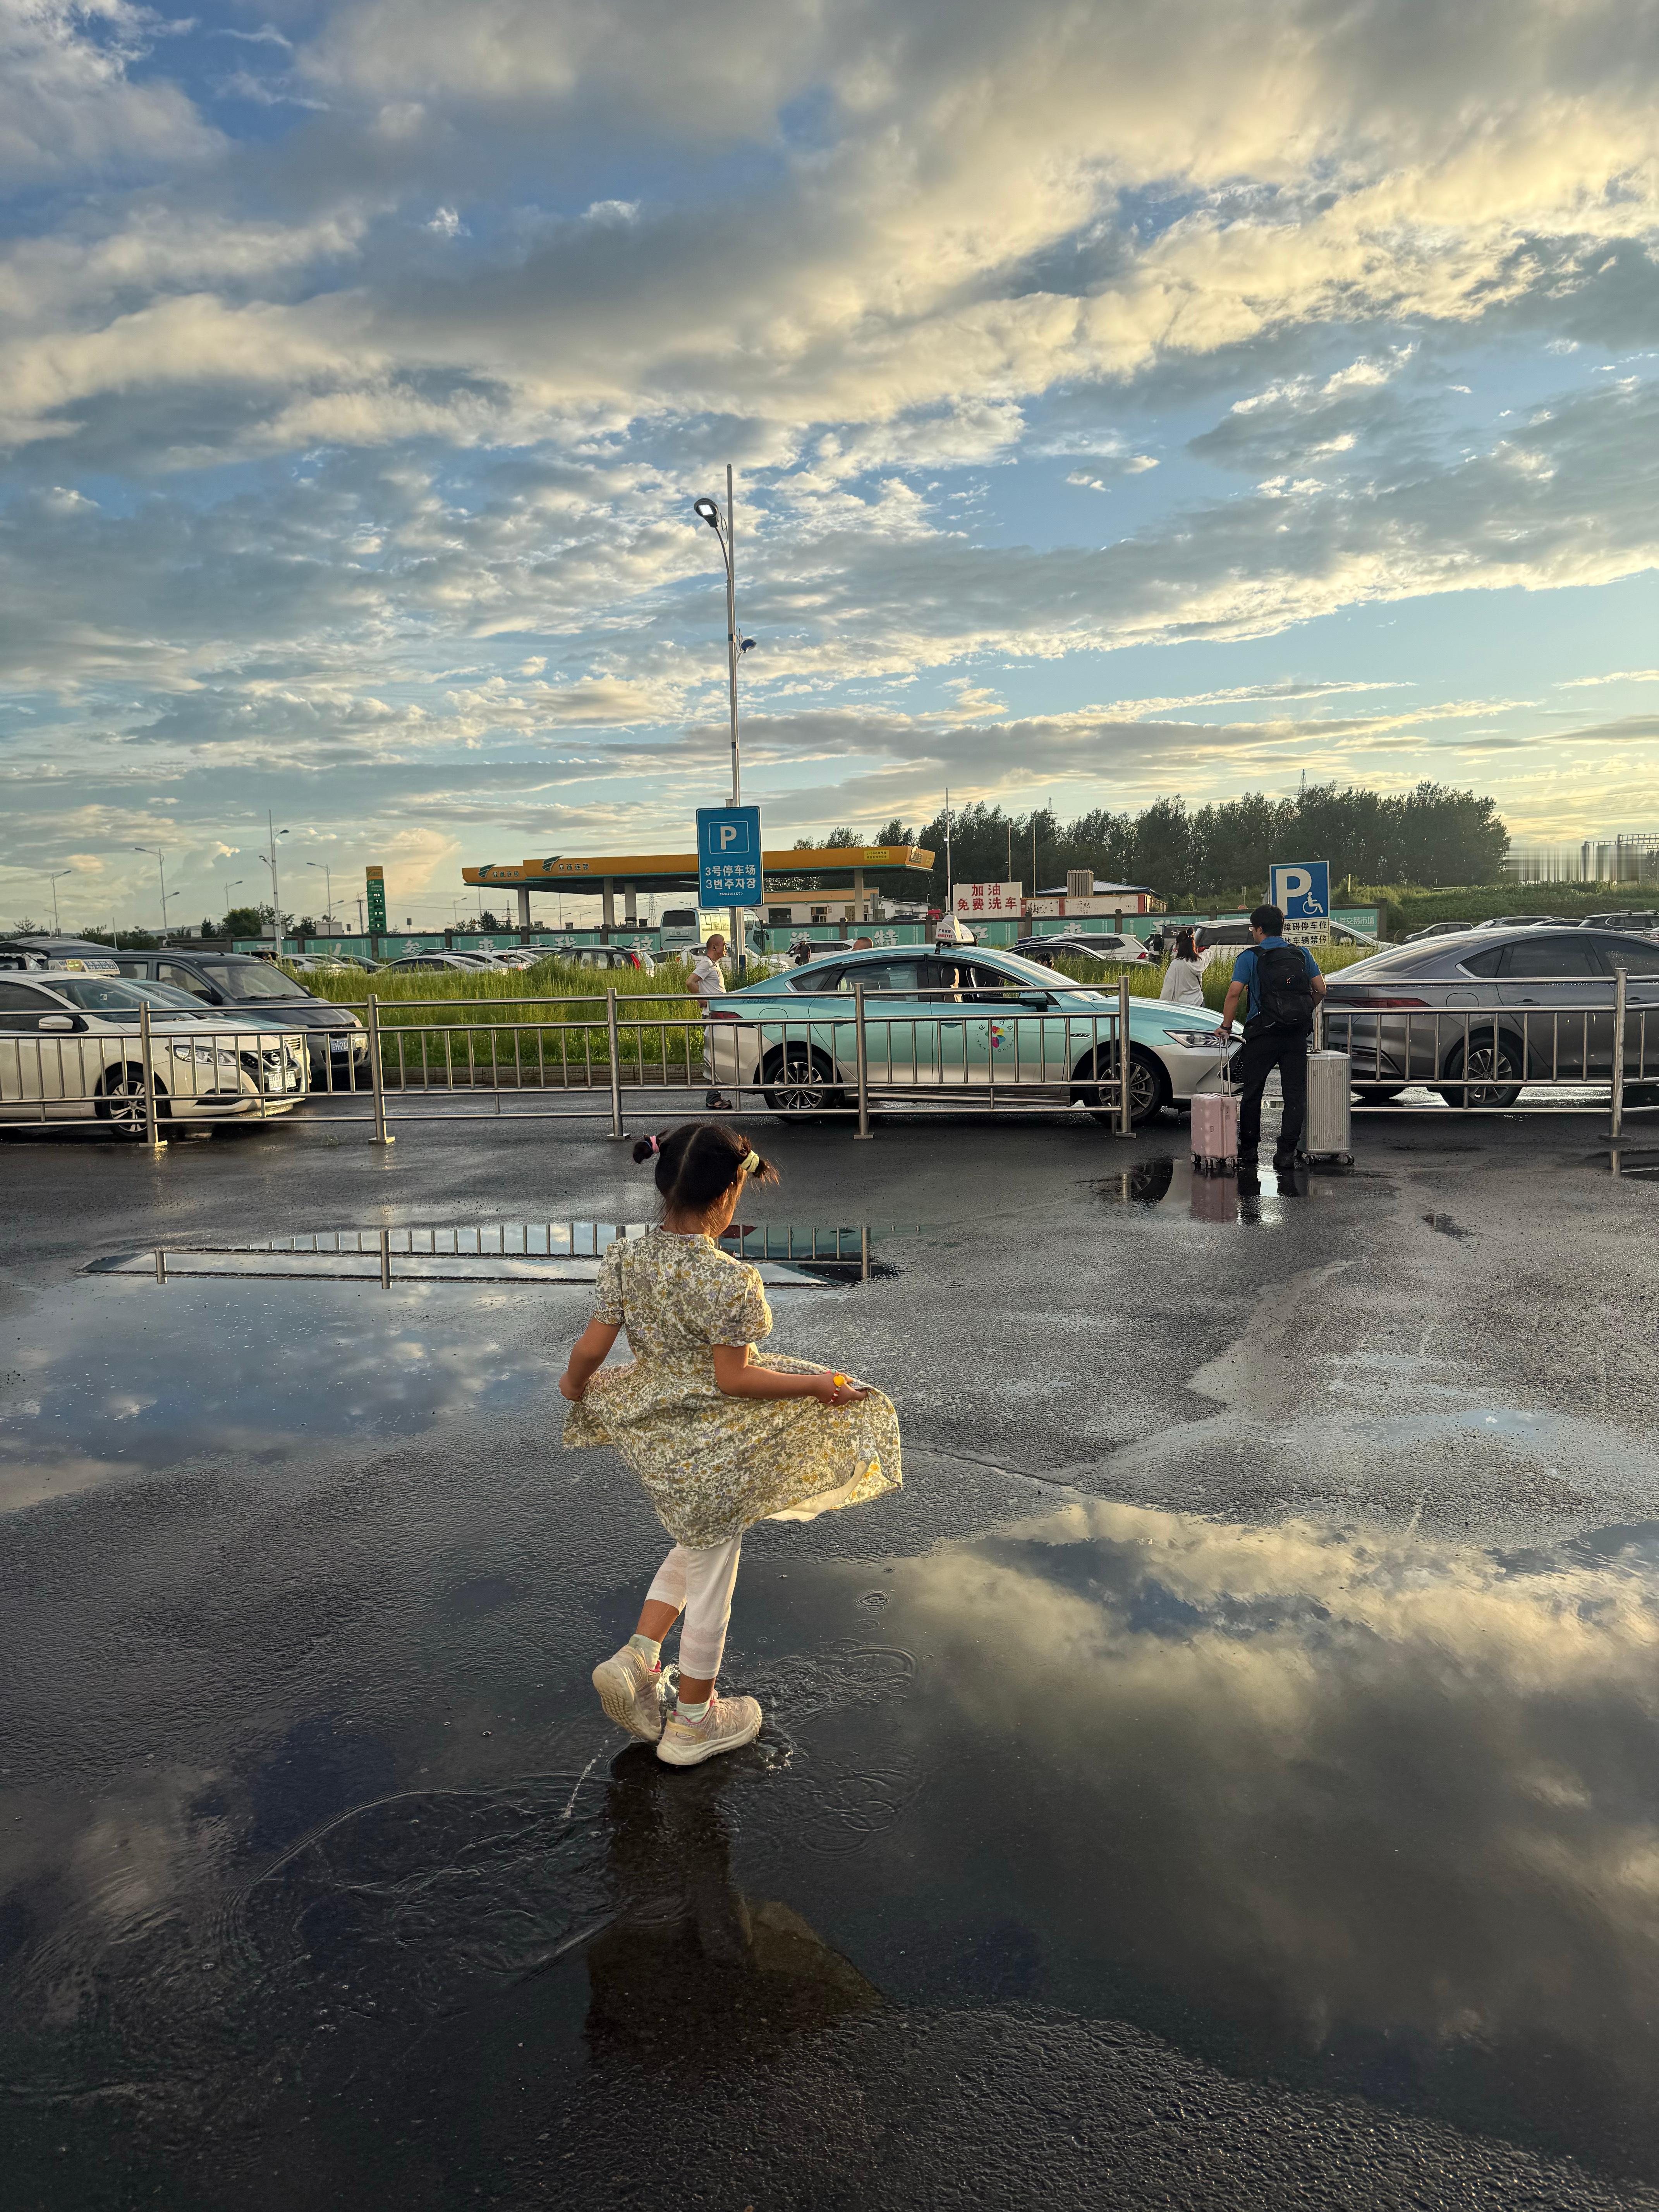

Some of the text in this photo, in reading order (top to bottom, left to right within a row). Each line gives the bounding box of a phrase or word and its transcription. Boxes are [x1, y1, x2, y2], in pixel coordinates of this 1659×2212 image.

[720, 826, 737, 850] P
[705, 864, 756, 876] 3号停车场
[971, 884, 1001, 896] 加油
[1276, 868, 1312, 915] P
[957, 897, 1017, 911] 免费洗车
